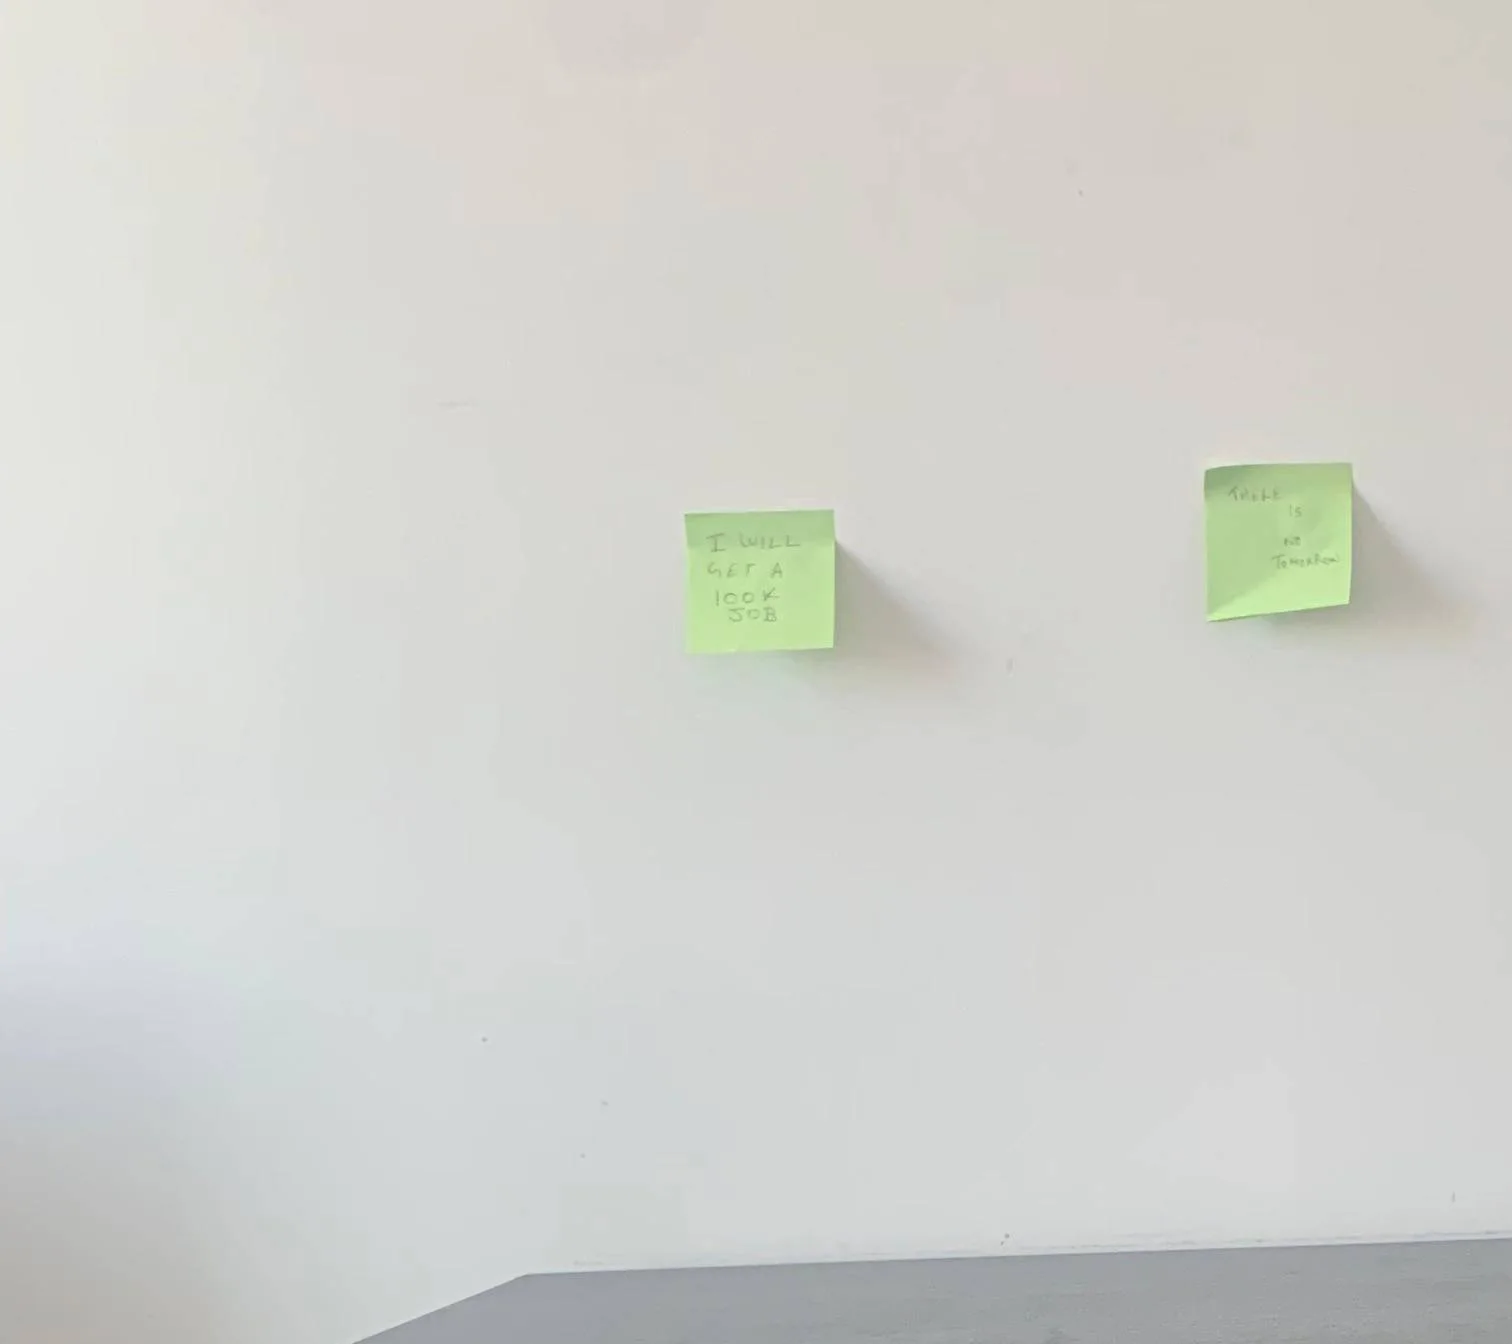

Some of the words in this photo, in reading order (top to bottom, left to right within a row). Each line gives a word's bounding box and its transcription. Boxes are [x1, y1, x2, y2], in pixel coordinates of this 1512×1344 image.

[706, 532, 727, 553] I
[739, 530, 801, 549] WILL
[706, 561, 757, 579] GET
[770, 562, 783, 579] A
[715, 587, 781, 607] 100K
[728, 606, 778, 623] JOB
